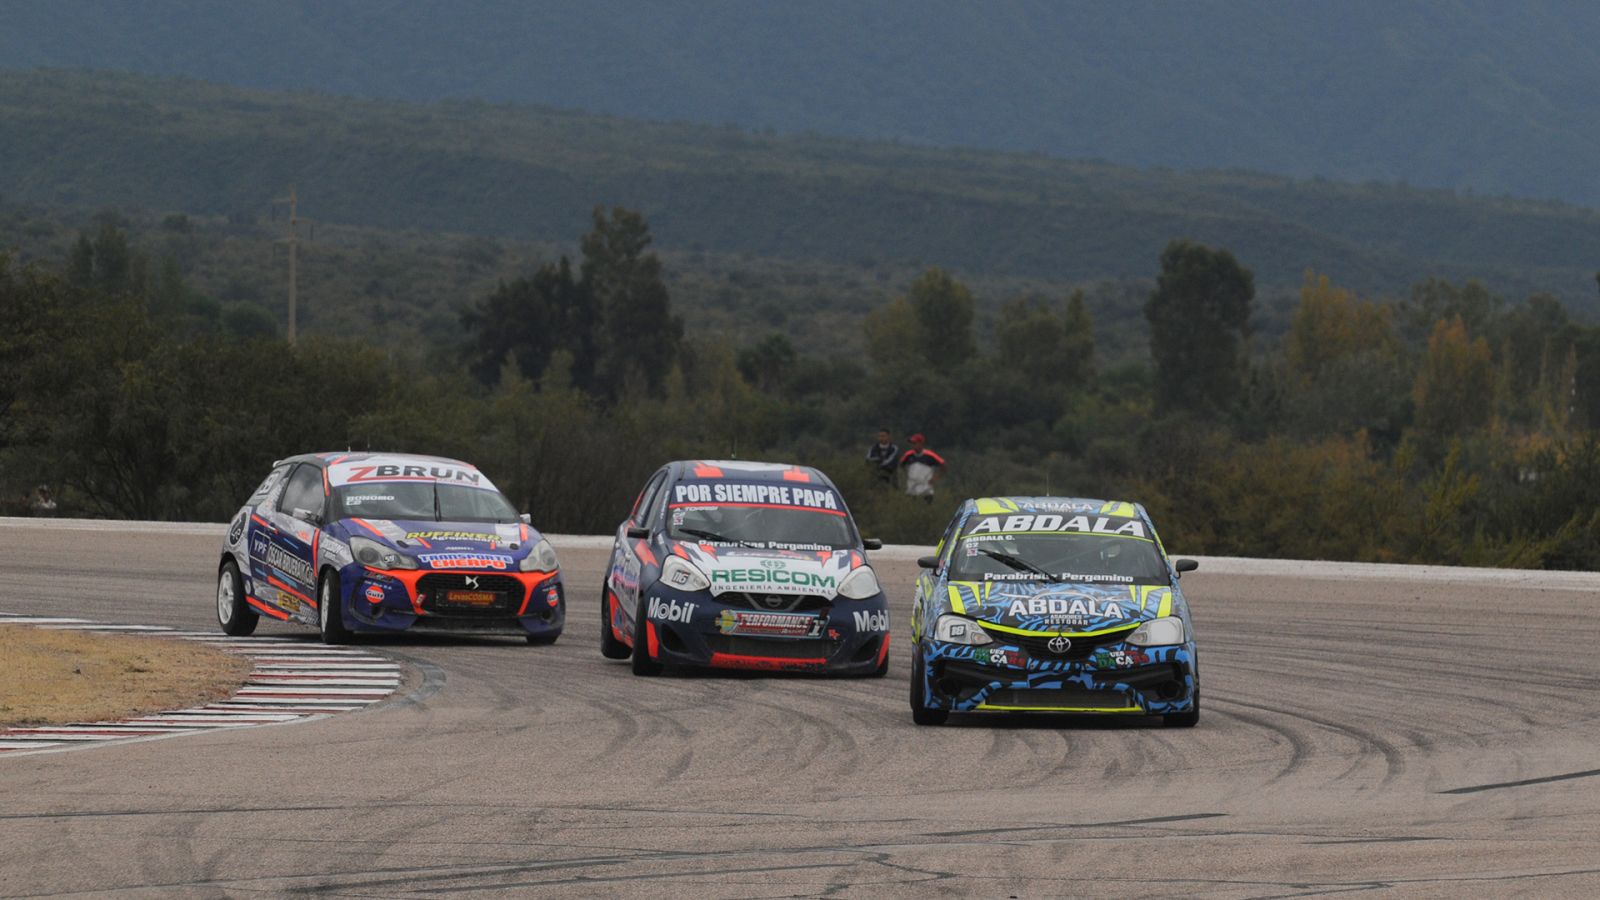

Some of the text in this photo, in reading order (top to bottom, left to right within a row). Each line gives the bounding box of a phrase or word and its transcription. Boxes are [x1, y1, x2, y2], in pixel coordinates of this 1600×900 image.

[675, 484, 837, 510] POR SIEMPRE PAPÁ
[969, 515, 1145, 537] ABDALA
[253, 539, 268, 553] YPF
[768, 541, 832, 551] Pergamino
[418, 554, 514, 564] TRANSPORTE
[671, 570, 690, 584] 116
[711, 569, 836, 588] RESICOM
[984, 572, 1134, 582] Parabrisa Pergamino
[777, 586, 834, 596] AMBIENTAL
[648, 597, 695, 623] Mobil
[1008, 600, 1123, 620] ABDALA
[739, 613, 811, 629] PERFORMANCE
